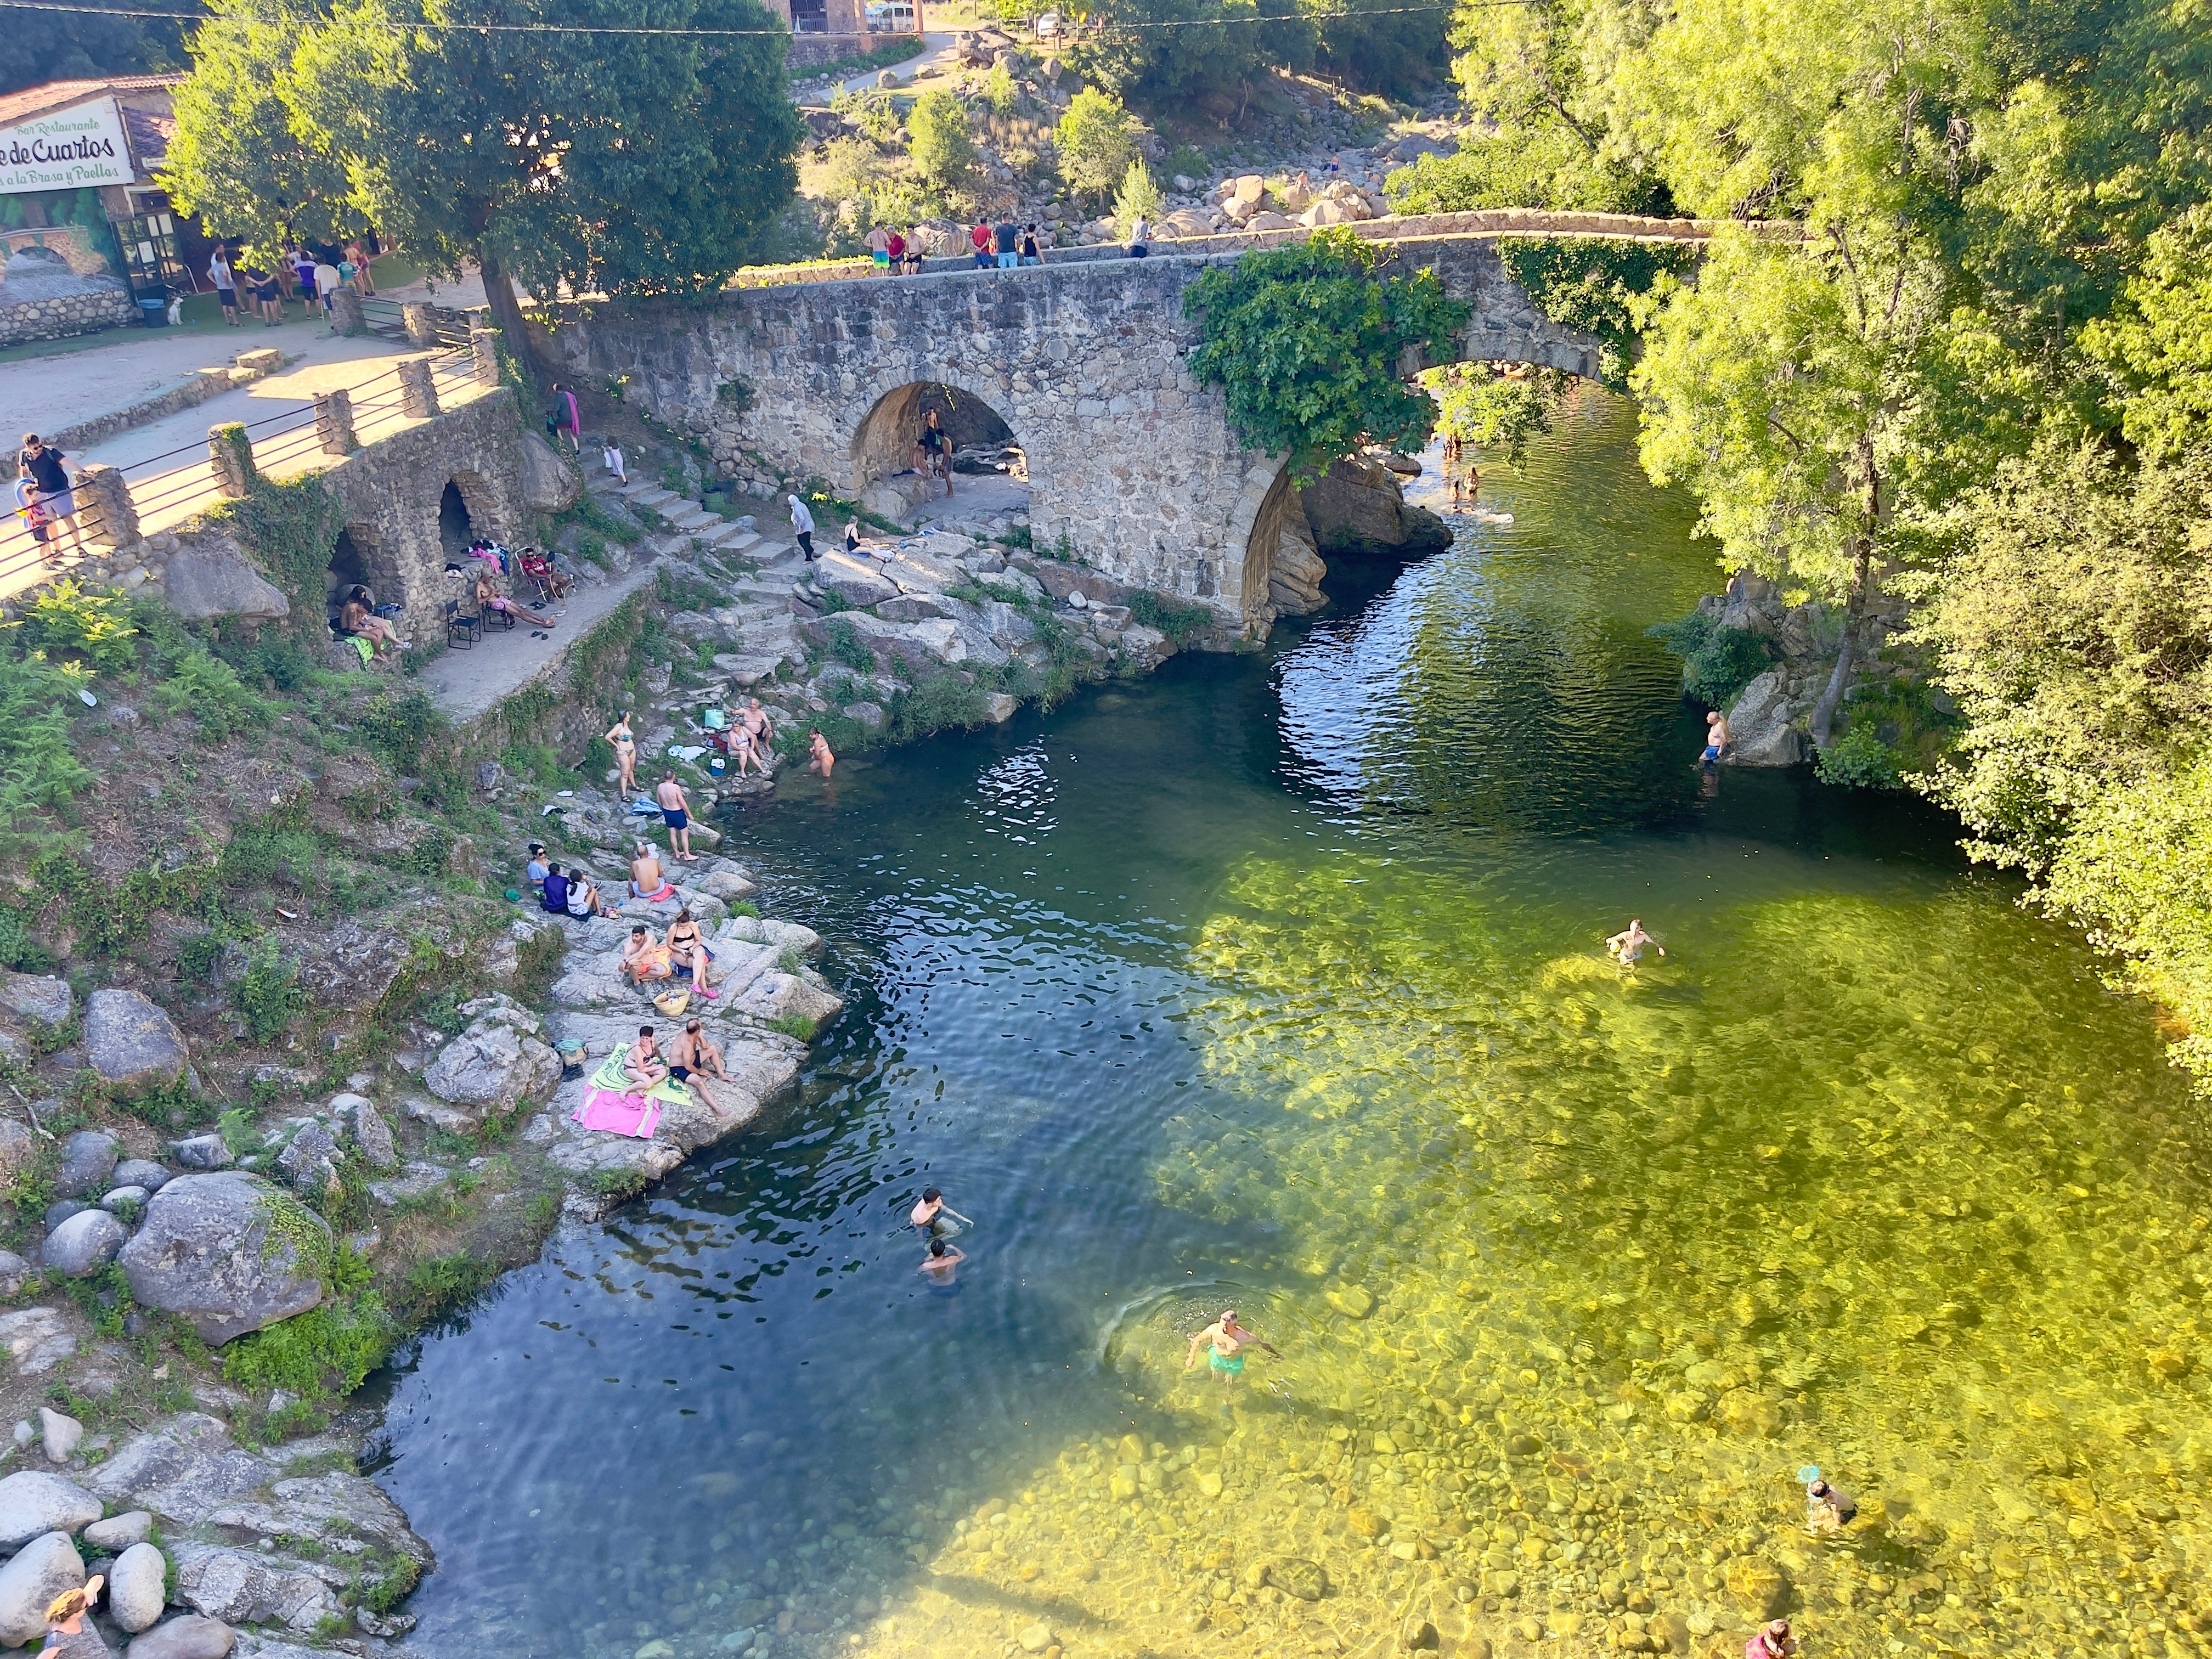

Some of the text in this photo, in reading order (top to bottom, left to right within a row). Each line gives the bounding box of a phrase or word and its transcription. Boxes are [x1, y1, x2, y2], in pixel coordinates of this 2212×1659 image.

[14, 118, 100, 136] Bar Restaurante
[9, 141, 32, 165] de
[32, 136, 115, 163] Cuartos
[26, 170, 64, 184] Brasa
[66, 171, 74, 185] y
[72, 163, 119, 179] Paellas
